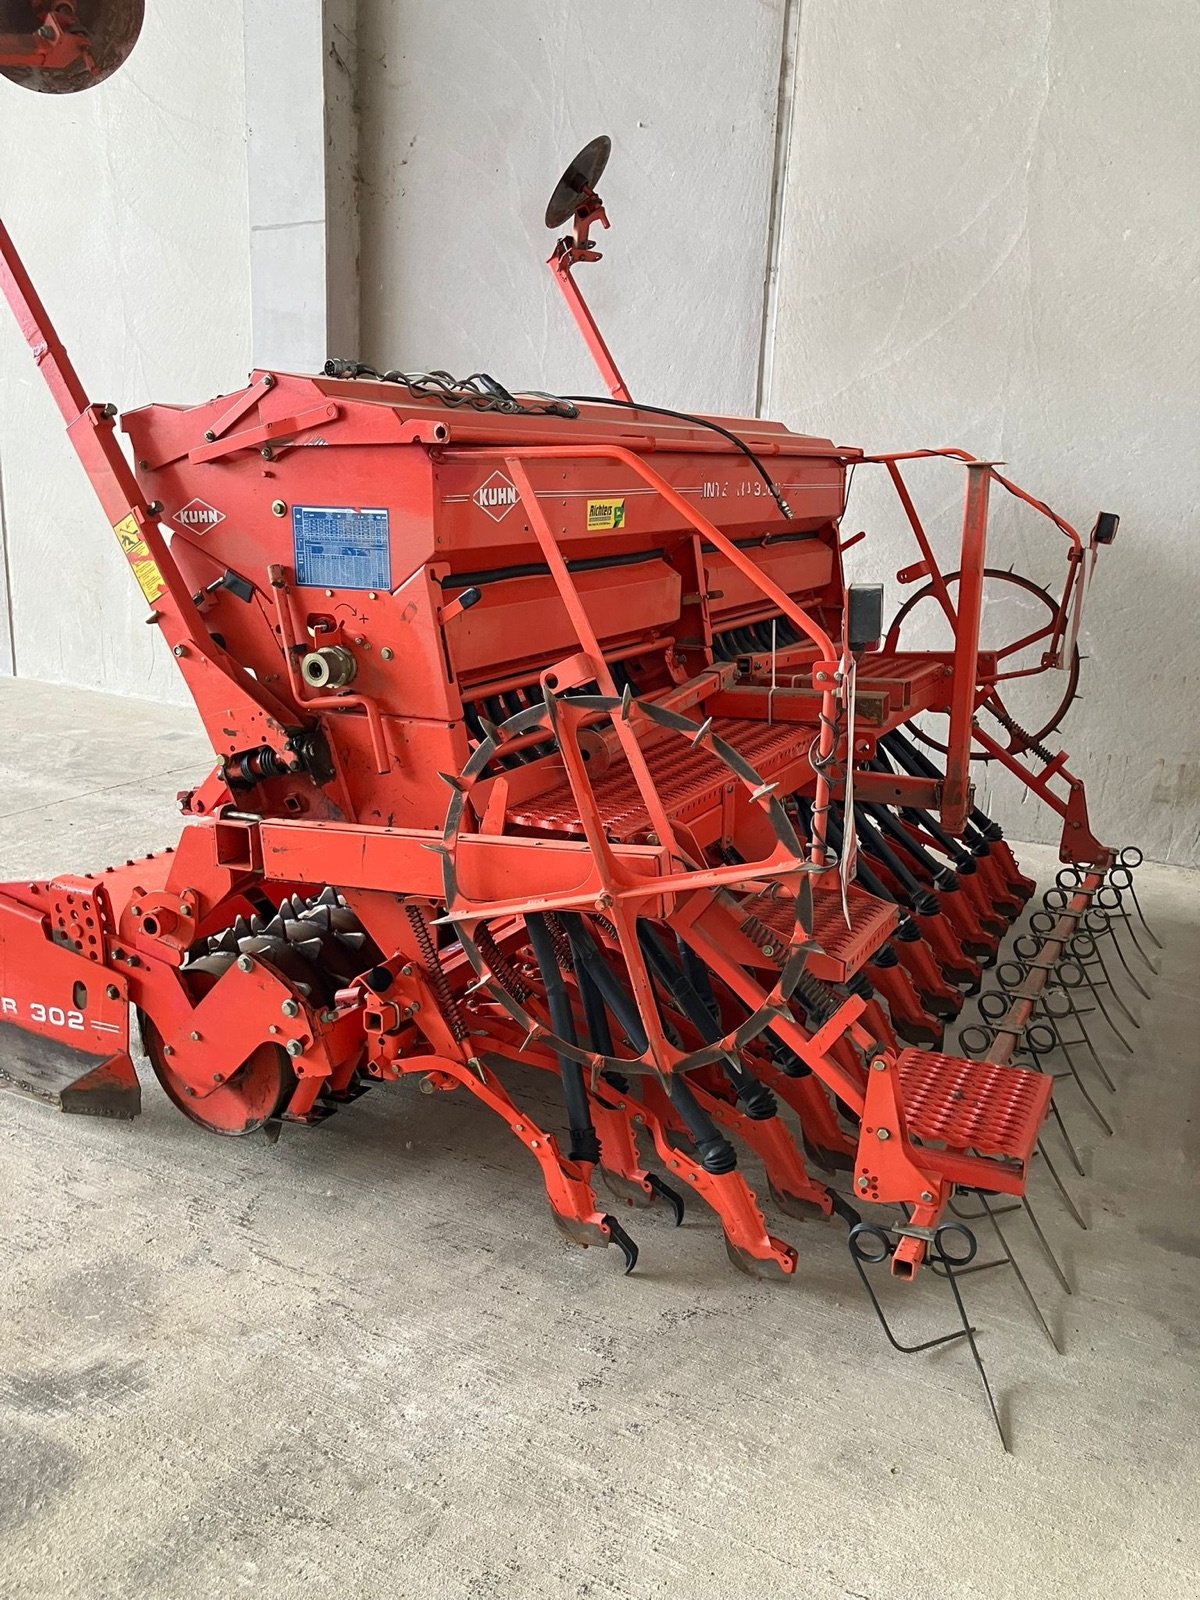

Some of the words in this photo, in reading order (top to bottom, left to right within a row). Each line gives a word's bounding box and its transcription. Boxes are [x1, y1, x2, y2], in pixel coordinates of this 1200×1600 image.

[479, 487, 516, 506] KUHN
[180, 510, 218, 523] KUHN
[30, 1002, 85, 1031] 302
